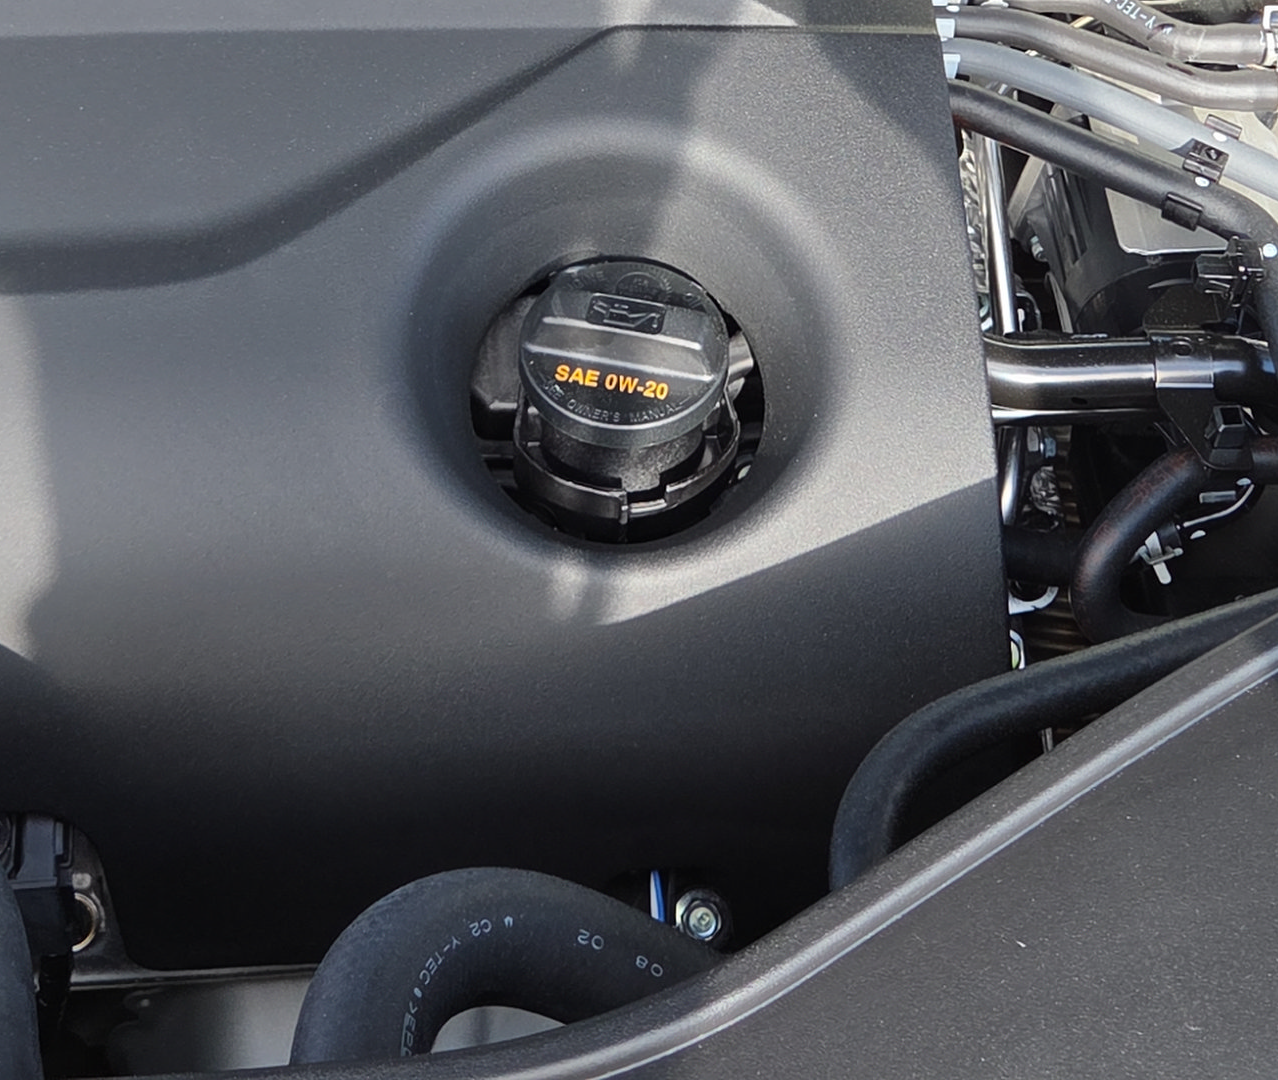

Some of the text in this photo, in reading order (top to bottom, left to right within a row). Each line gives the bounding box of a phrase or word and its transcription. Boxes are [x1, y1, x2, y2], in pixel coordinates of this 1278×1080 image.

[541, 380, 690, 424] SEE OWNER'S MANUAL
[553, 363, 670, 401] SAE 0W-20
[418, 935, 462, 986] Y-TEC
